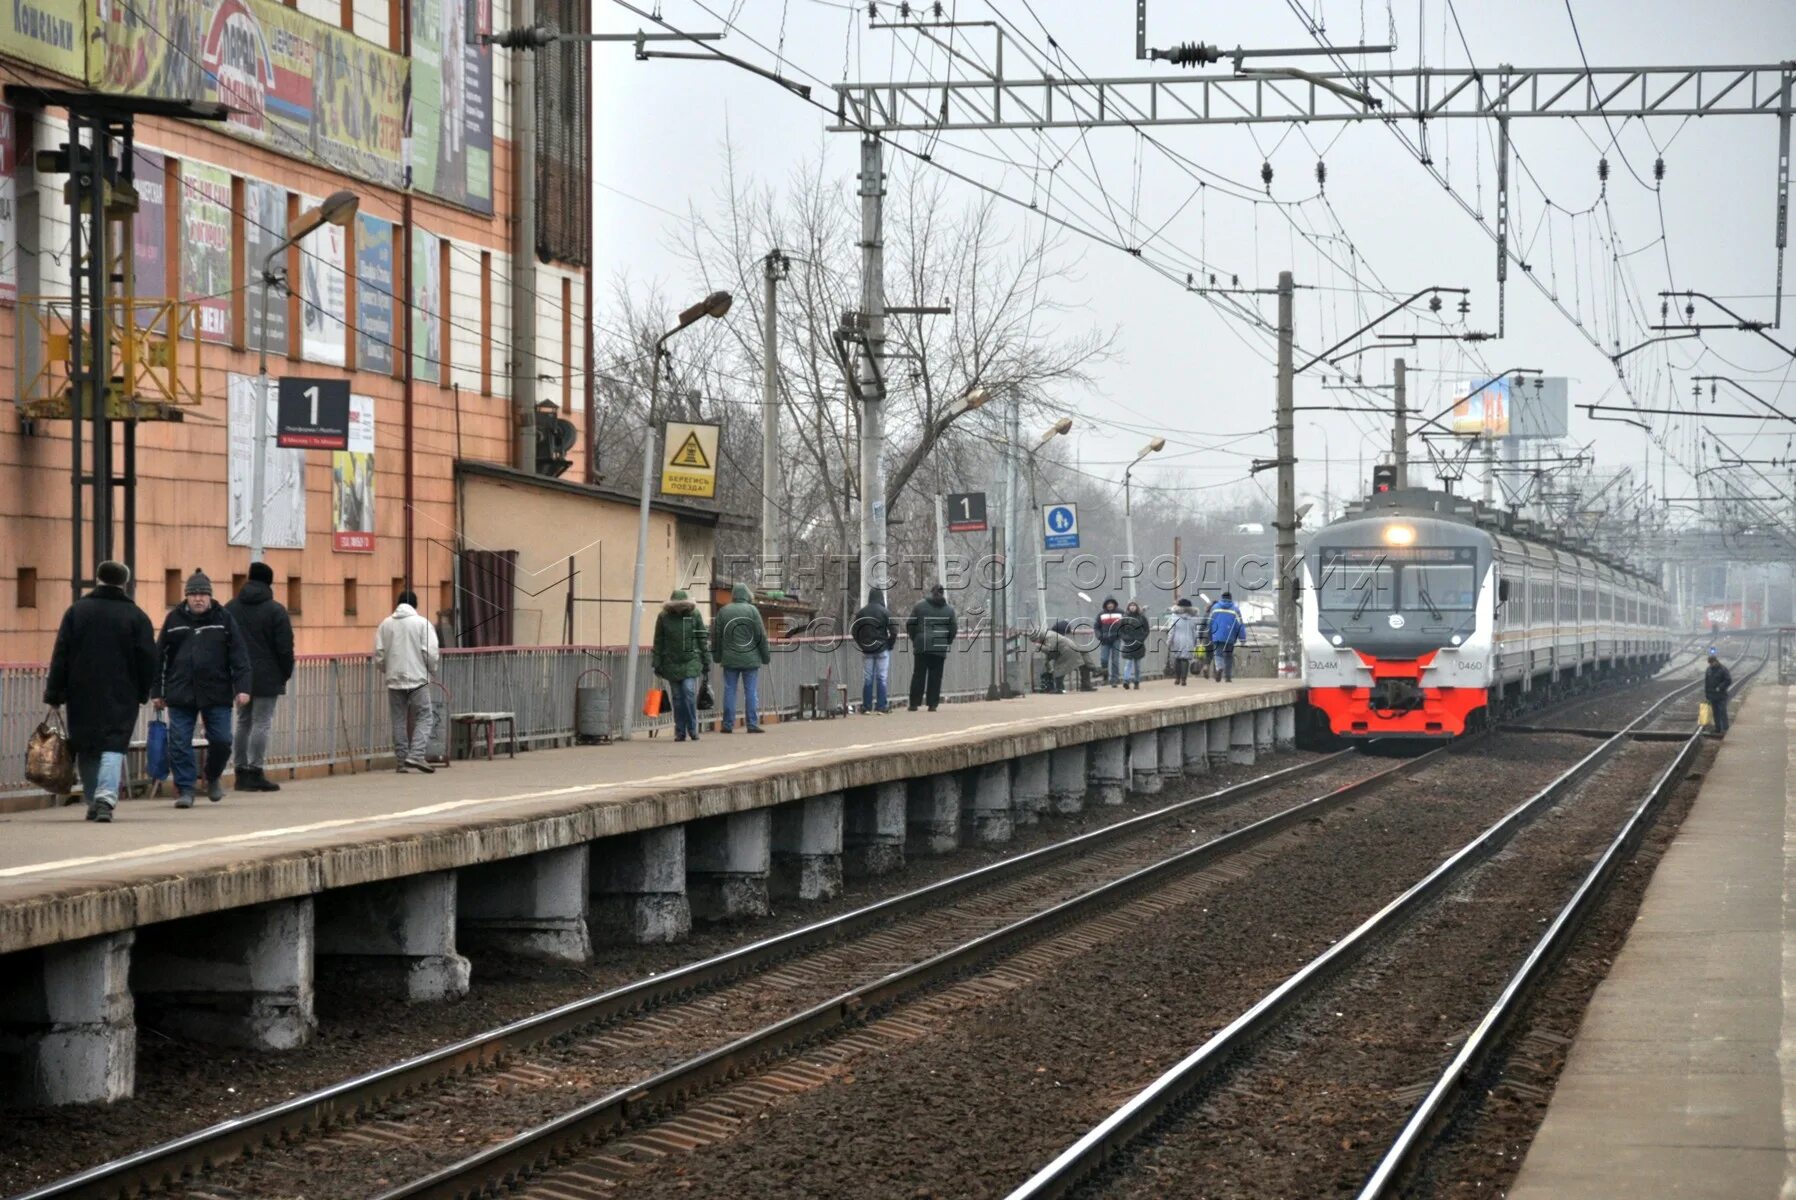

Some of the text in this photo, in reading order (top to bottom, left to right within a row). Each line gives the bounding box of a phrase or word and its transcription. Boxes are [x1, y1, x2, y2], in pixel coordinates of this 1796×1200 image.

[303, 386, 319, 425] 1
[669, 475, 710, 485] БЕРЕГИСЬ
[671, 483, 706, 492] ПОЕЗДА!
[960, 497, 970, 520] 1
[1309, 661, 1338, 670] ЭД4М
[1458, 660, 1483, 670] 0460
